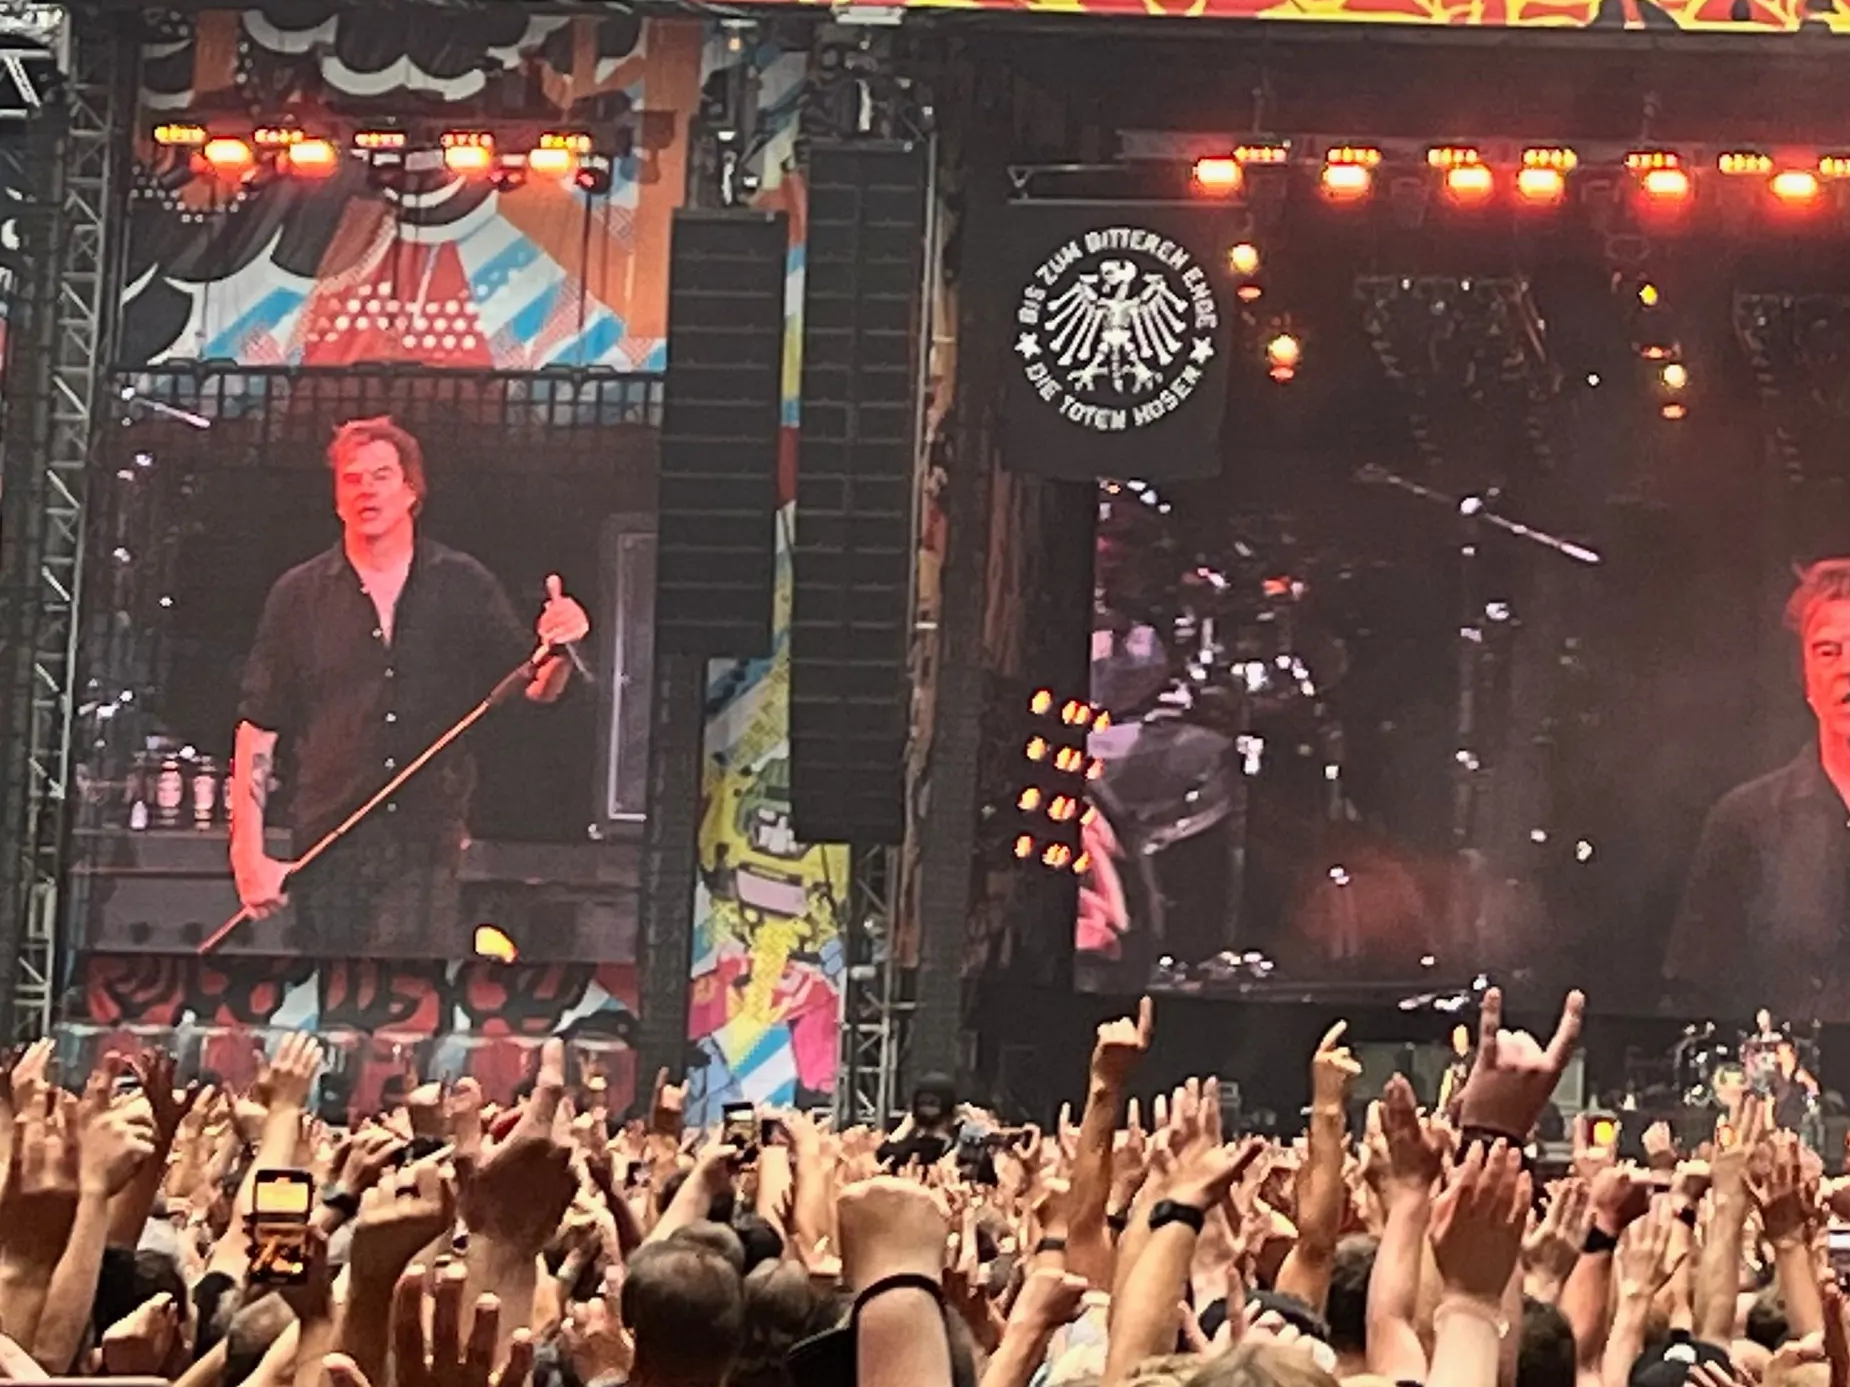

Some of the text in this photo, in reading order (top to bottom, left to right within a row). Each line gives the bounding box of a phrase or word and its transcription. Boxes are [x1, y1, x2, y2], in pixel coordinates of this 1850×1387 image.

[1034, 240, 1083, 286] ZUM
[1181, 266, 1218, 329] ENDE
[1024, 362, 1202, 430] DIE TOTEN HOSEN
